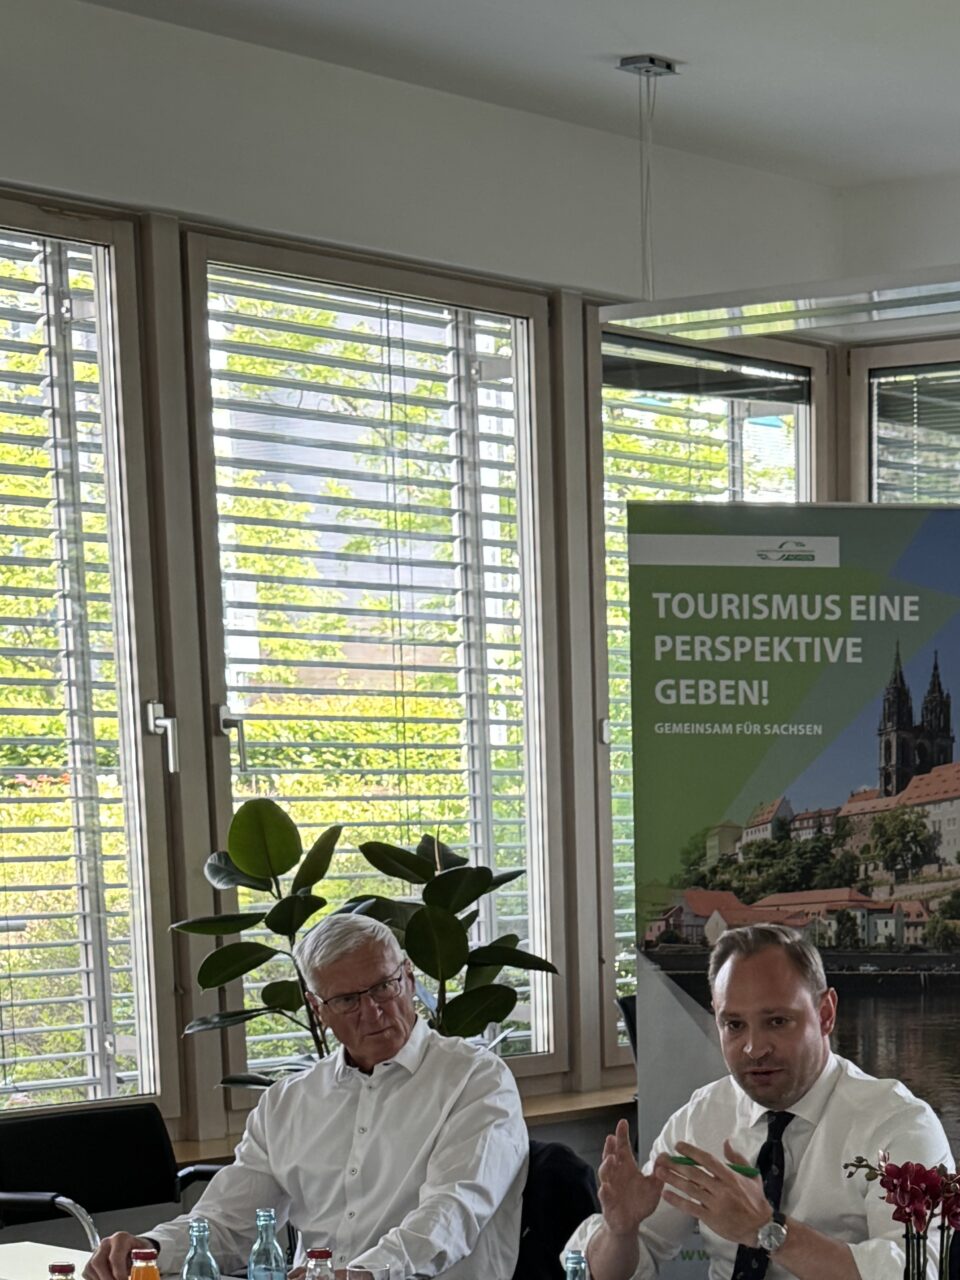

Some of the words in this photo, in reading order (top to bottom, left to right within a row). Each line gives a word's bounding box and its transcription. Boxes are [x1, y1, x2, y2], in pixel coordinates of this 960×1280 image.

[652, 592, 842, 621] TOURISMUS
[850, 595, 920, 622] EINE
[654, 635, 863, 663] PERSPEKTIVE
[654, 678, 770, 706] GEBEN!
[654, 722, 733, 735] GEMEINSAM
[735, 720, 761, 735] FÜR
[764, 723, 823, 736] SACHSEN
